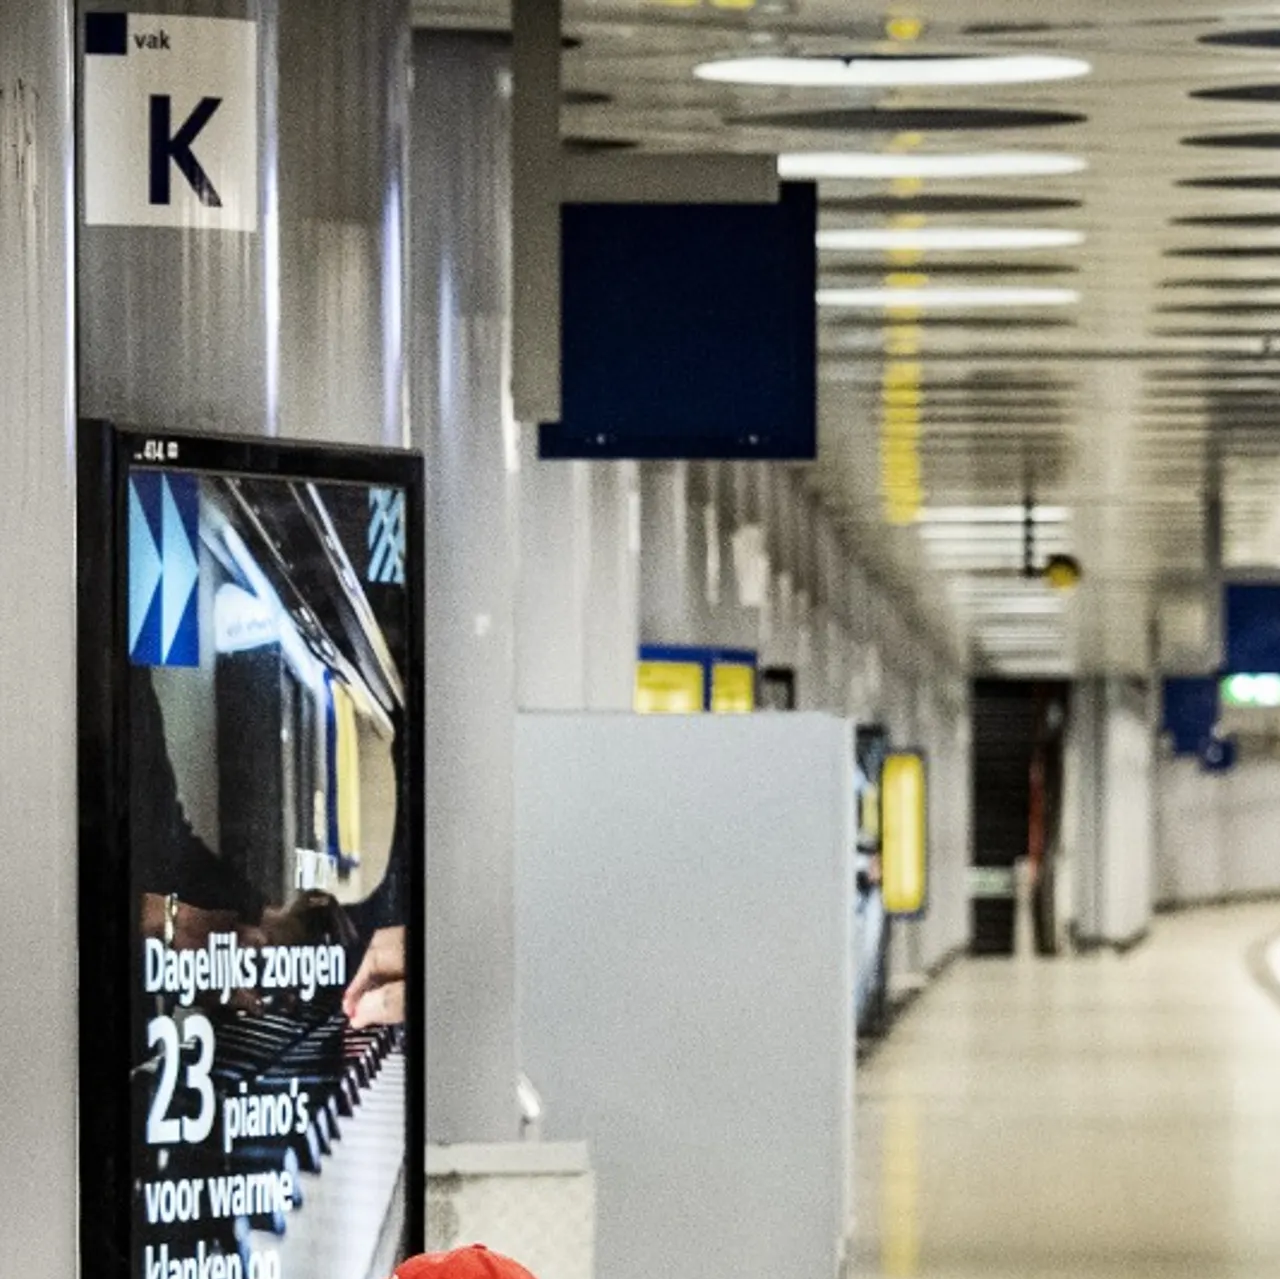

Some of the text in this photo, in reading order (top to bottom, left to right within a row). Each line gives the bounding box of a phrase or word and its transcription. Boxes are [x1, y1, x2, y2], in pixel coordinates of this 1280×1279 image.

[133, 29, 170, 50] vak
[148, 94, 223, 208] K
[145, 931, 346, 1006] Dagelijks zorgen
[146, 1014, 309, 1152] 23 piano's
[145, 1170, 293, 1224] voor warme
